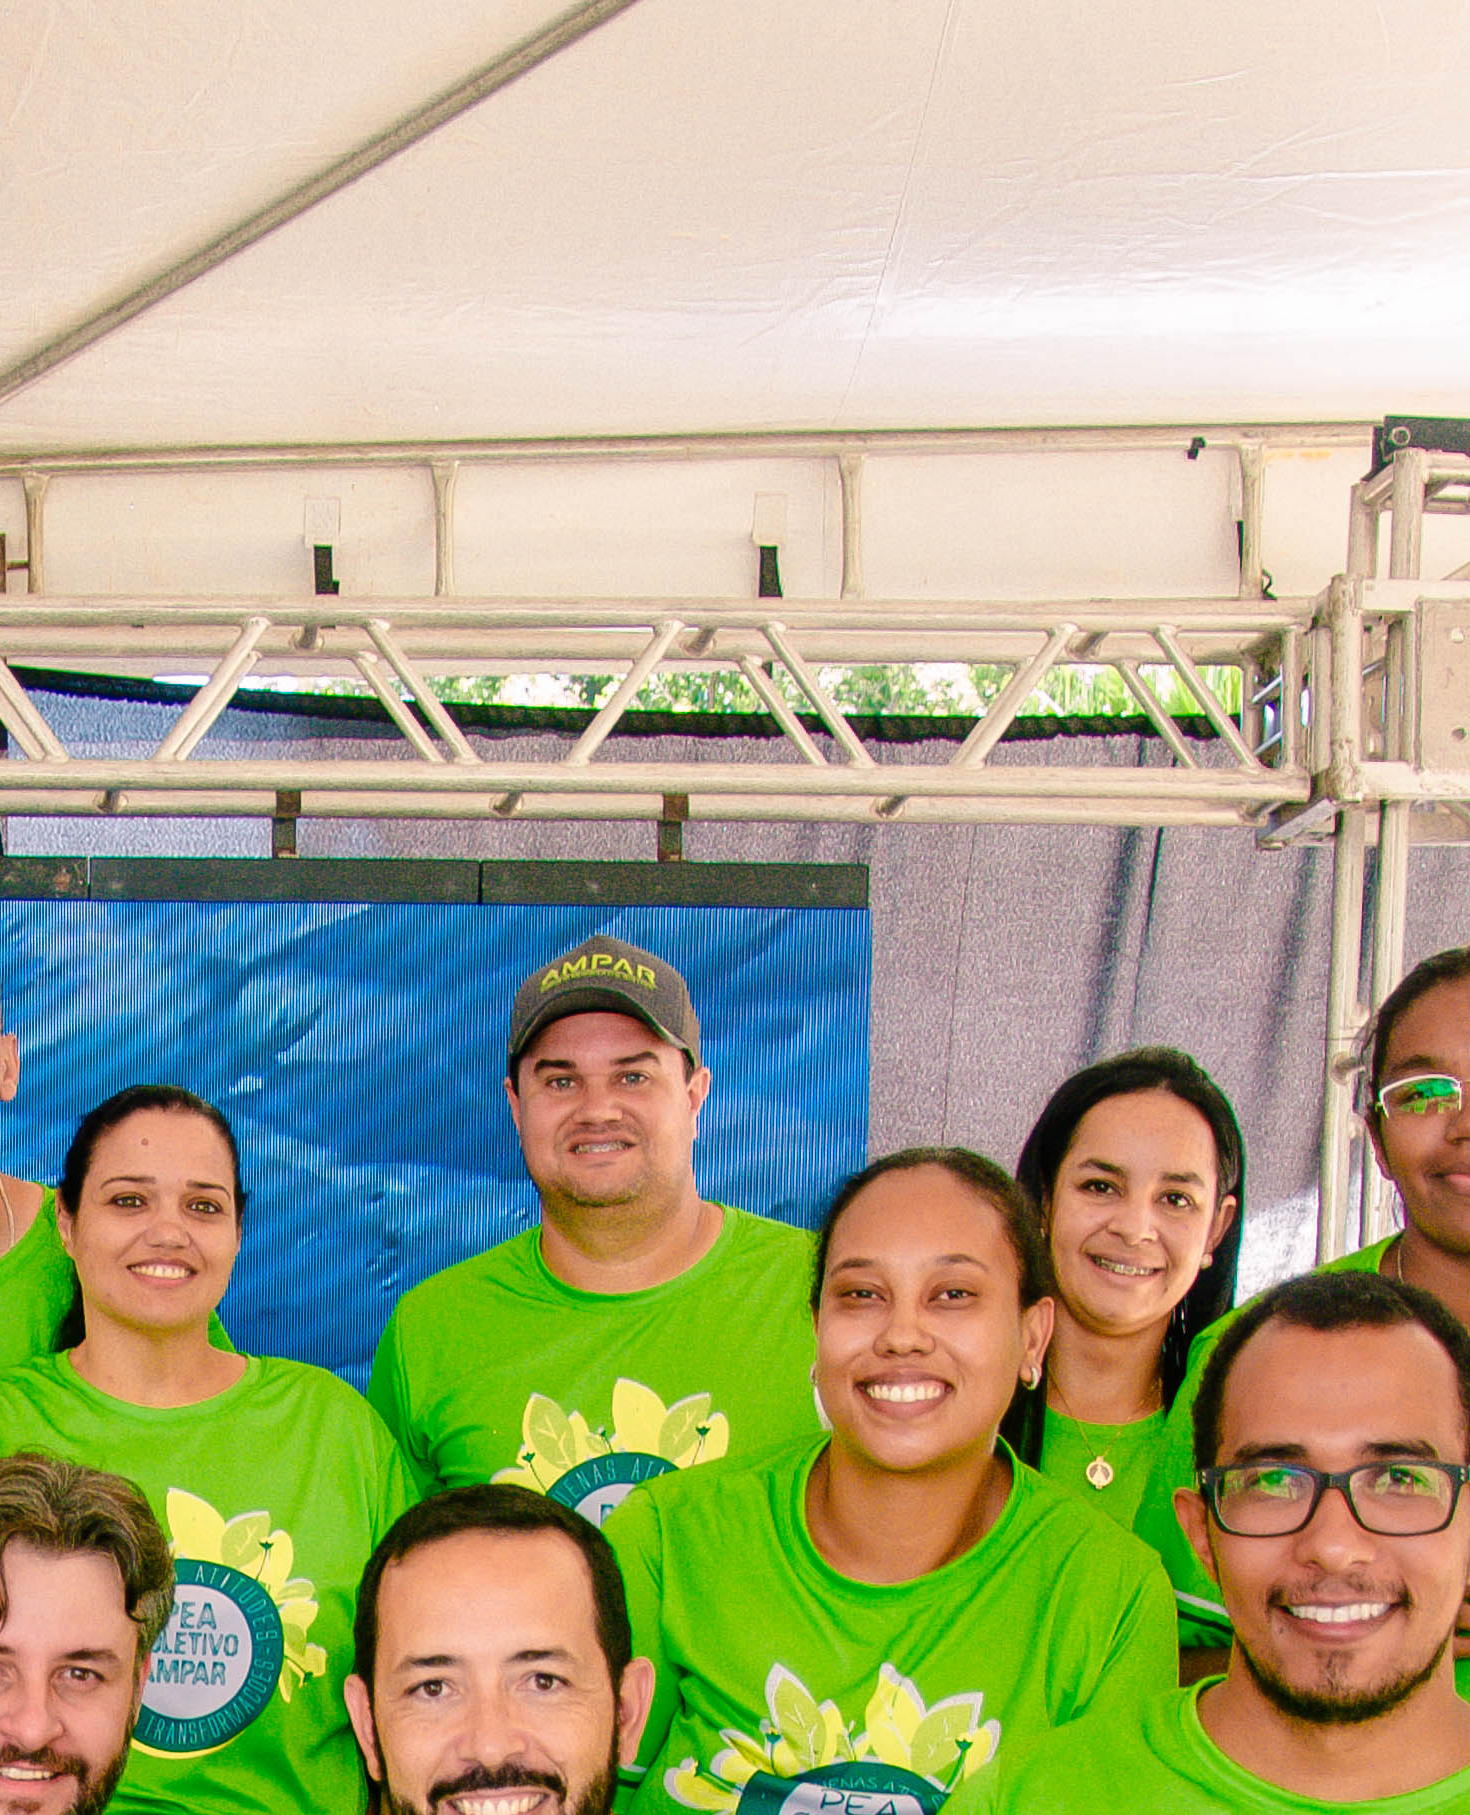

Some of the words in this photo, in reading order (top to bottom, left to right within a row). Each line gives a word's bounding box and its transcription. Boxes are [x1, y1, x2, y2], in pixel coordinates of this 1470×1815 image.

[540, 954, 657, 992] AMPAR
[195, 1564, 278, 1641] ATITUDES
[152, 1631, 239, 1656] LETIVO
